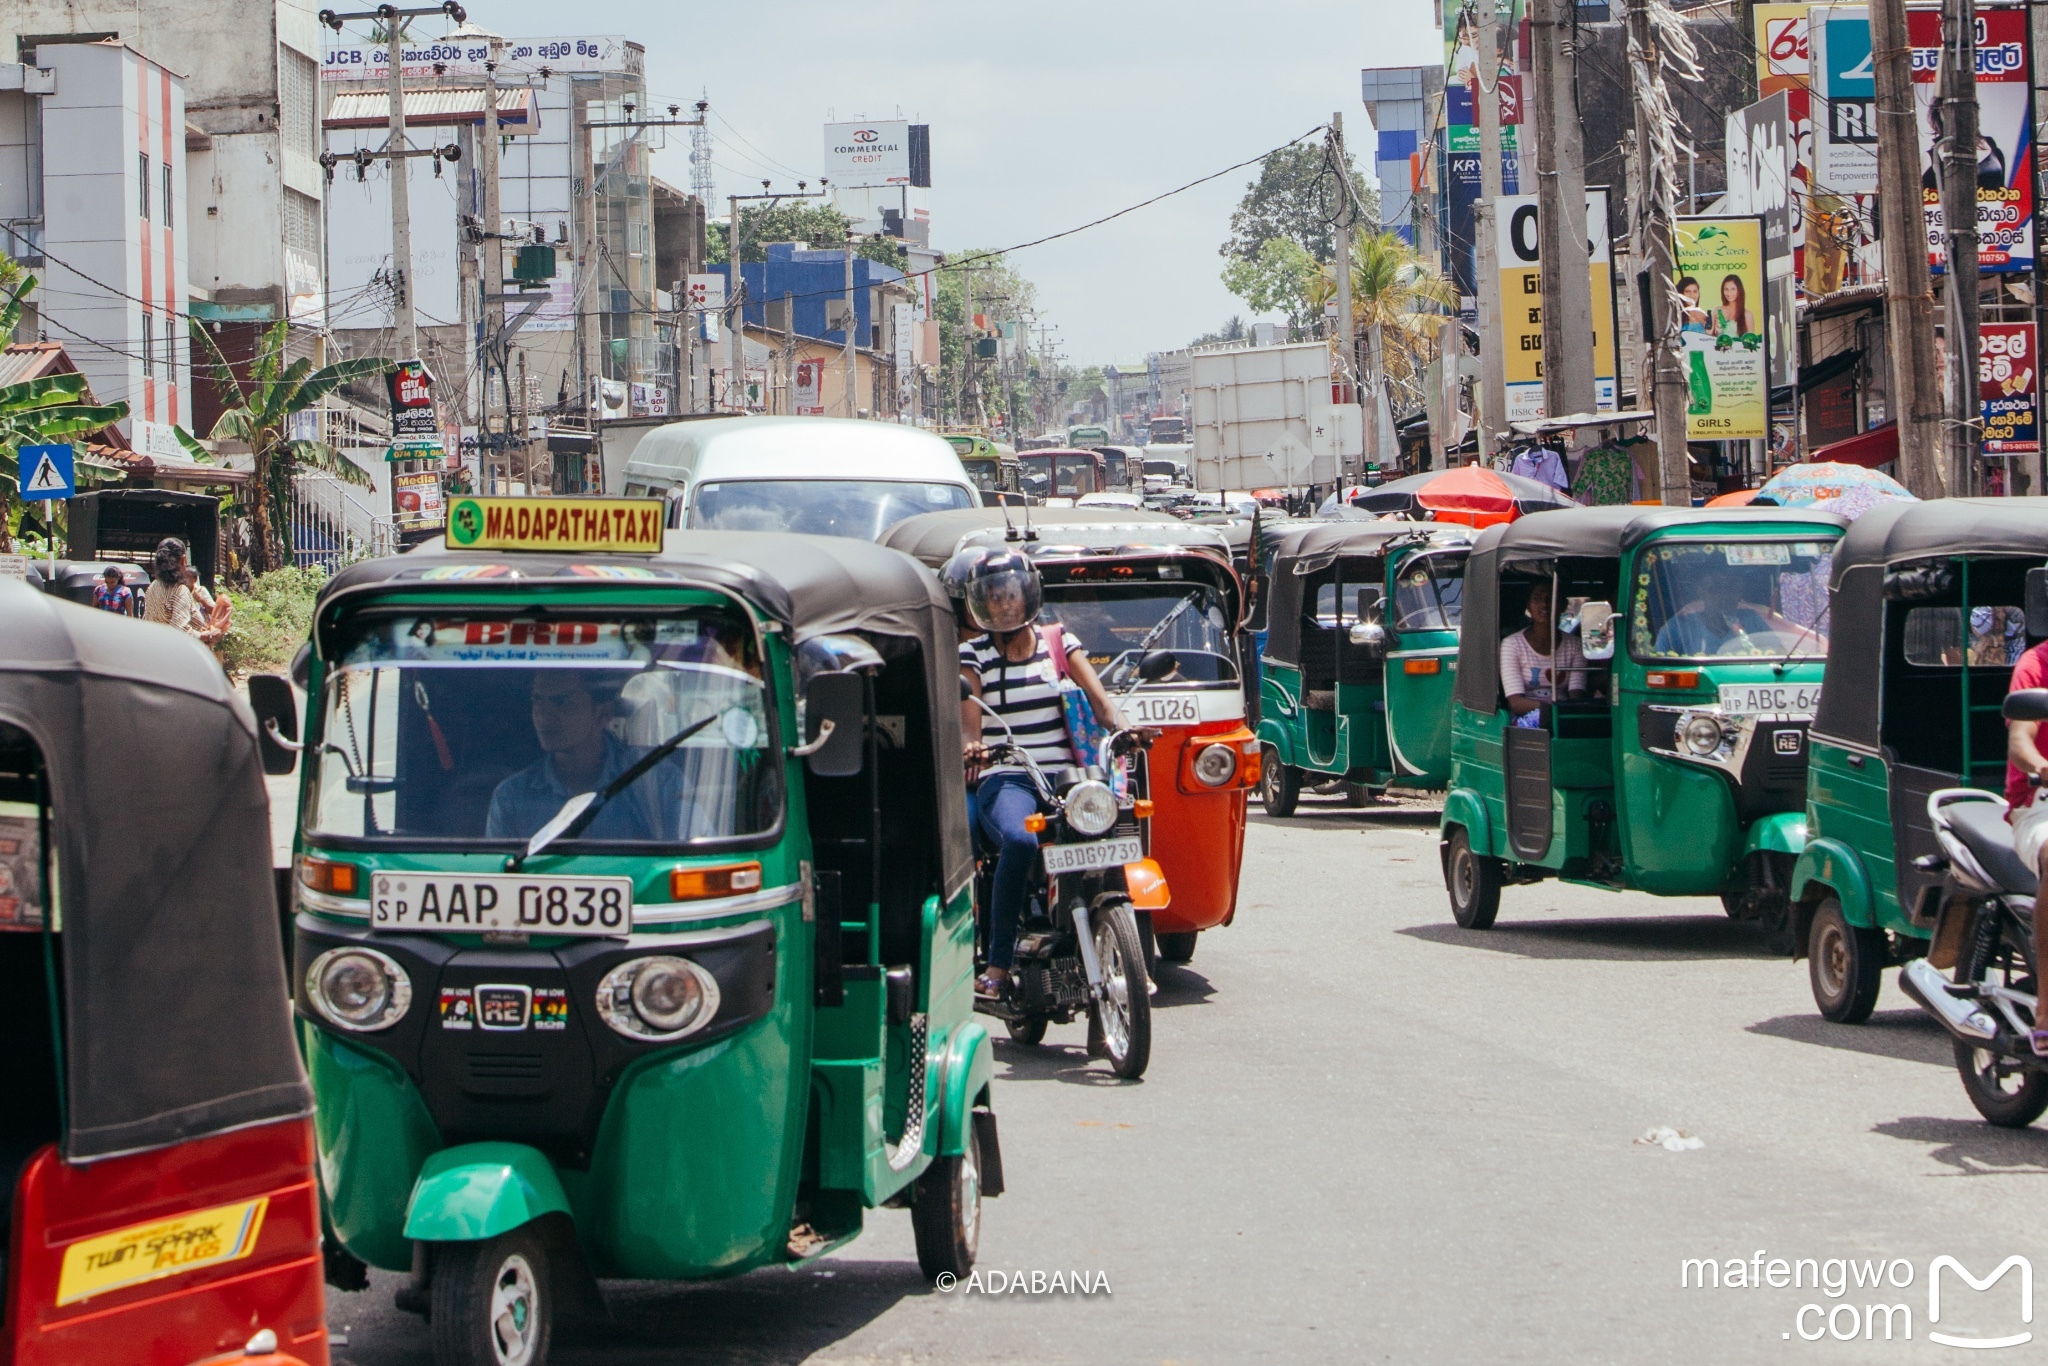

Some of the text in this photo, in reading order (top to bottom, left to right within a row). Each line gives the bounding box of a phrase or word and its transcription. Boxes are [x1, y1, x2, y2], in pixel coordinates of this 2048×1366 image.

[326, 50, 362, 65] JCB
[834, 144, 899, 154] COMMERCIAL
[851, 155, 882, 163] CREDIT
[1829, 172, 1879, 181] Empowerin
[1977, 186, 2021, 202] රකථන
[1702, 262, 1747, 272] shampoo
[401, 379, 419, 390] city
[1511, 408, 1534, 417] HSBC
[1697, 418, 1731, 428] GIRLS
[398, 474, 436, 487] Media
[1137, 700, 1196, 721] 1026
[1725, 699, 1741, 711] UP
[1779, 737, 1797, 750] RE
[418, 882, 498, 924] AAP
[518, 885, 623, 927] 0838
[485, 1001, 520, 1022] RE
[155, 1239, 221, 1269] PLUGS
